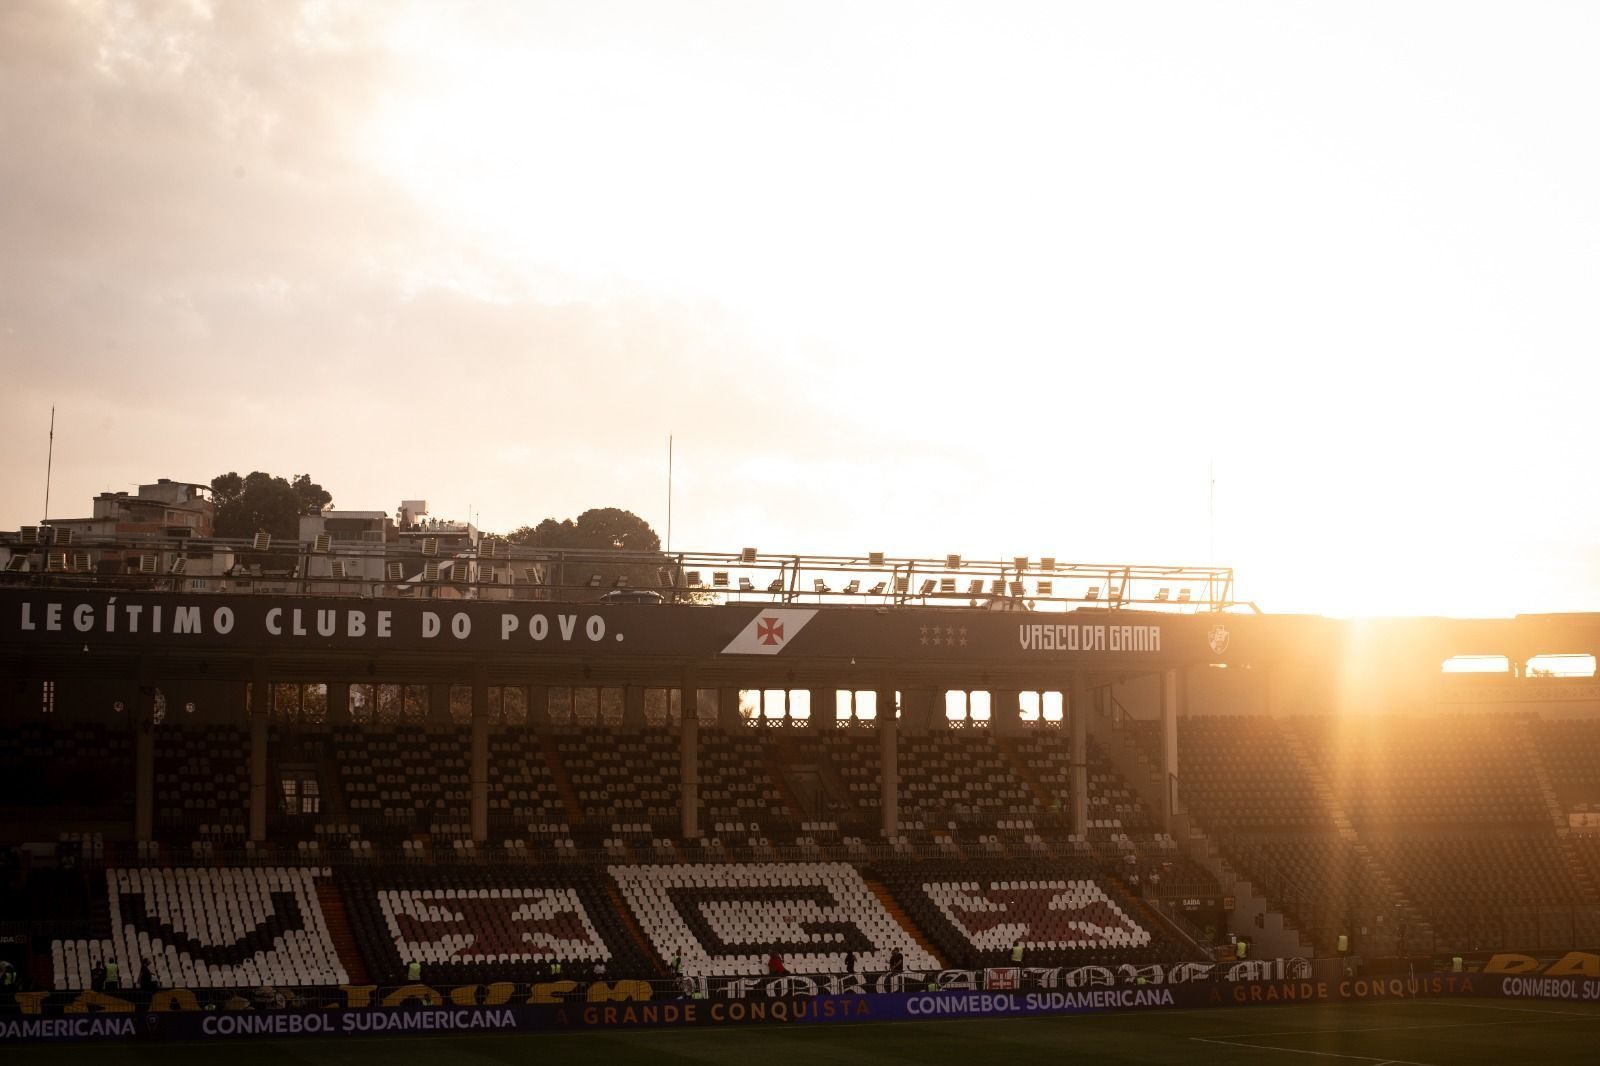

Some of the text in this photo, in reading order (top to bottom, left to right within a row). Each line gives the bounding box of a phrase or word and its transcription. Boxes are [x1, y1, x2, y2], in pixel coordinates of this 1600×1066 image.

[20, 597, 624, 642] LEGÍTIMO CLUBE DO POVO.
[1019, 624, 1161, 651] VASCO DA GAMA
[1234, 981, 1328, 1001] GRANDE
[1340, 977, 1474, 998] CONQUISTA
[1502, 976, 1578, 999] CONMEBOL
[584, 1004, 697, 1024] GRANDE
[710, 1000, 870, 1022] CONQUISTA
[906, 989, 1174, 1016] CONMEBOL SUDAMERICANA
[202, 1010, 516, 1034] CONMEBOL SUDAMERICANA
